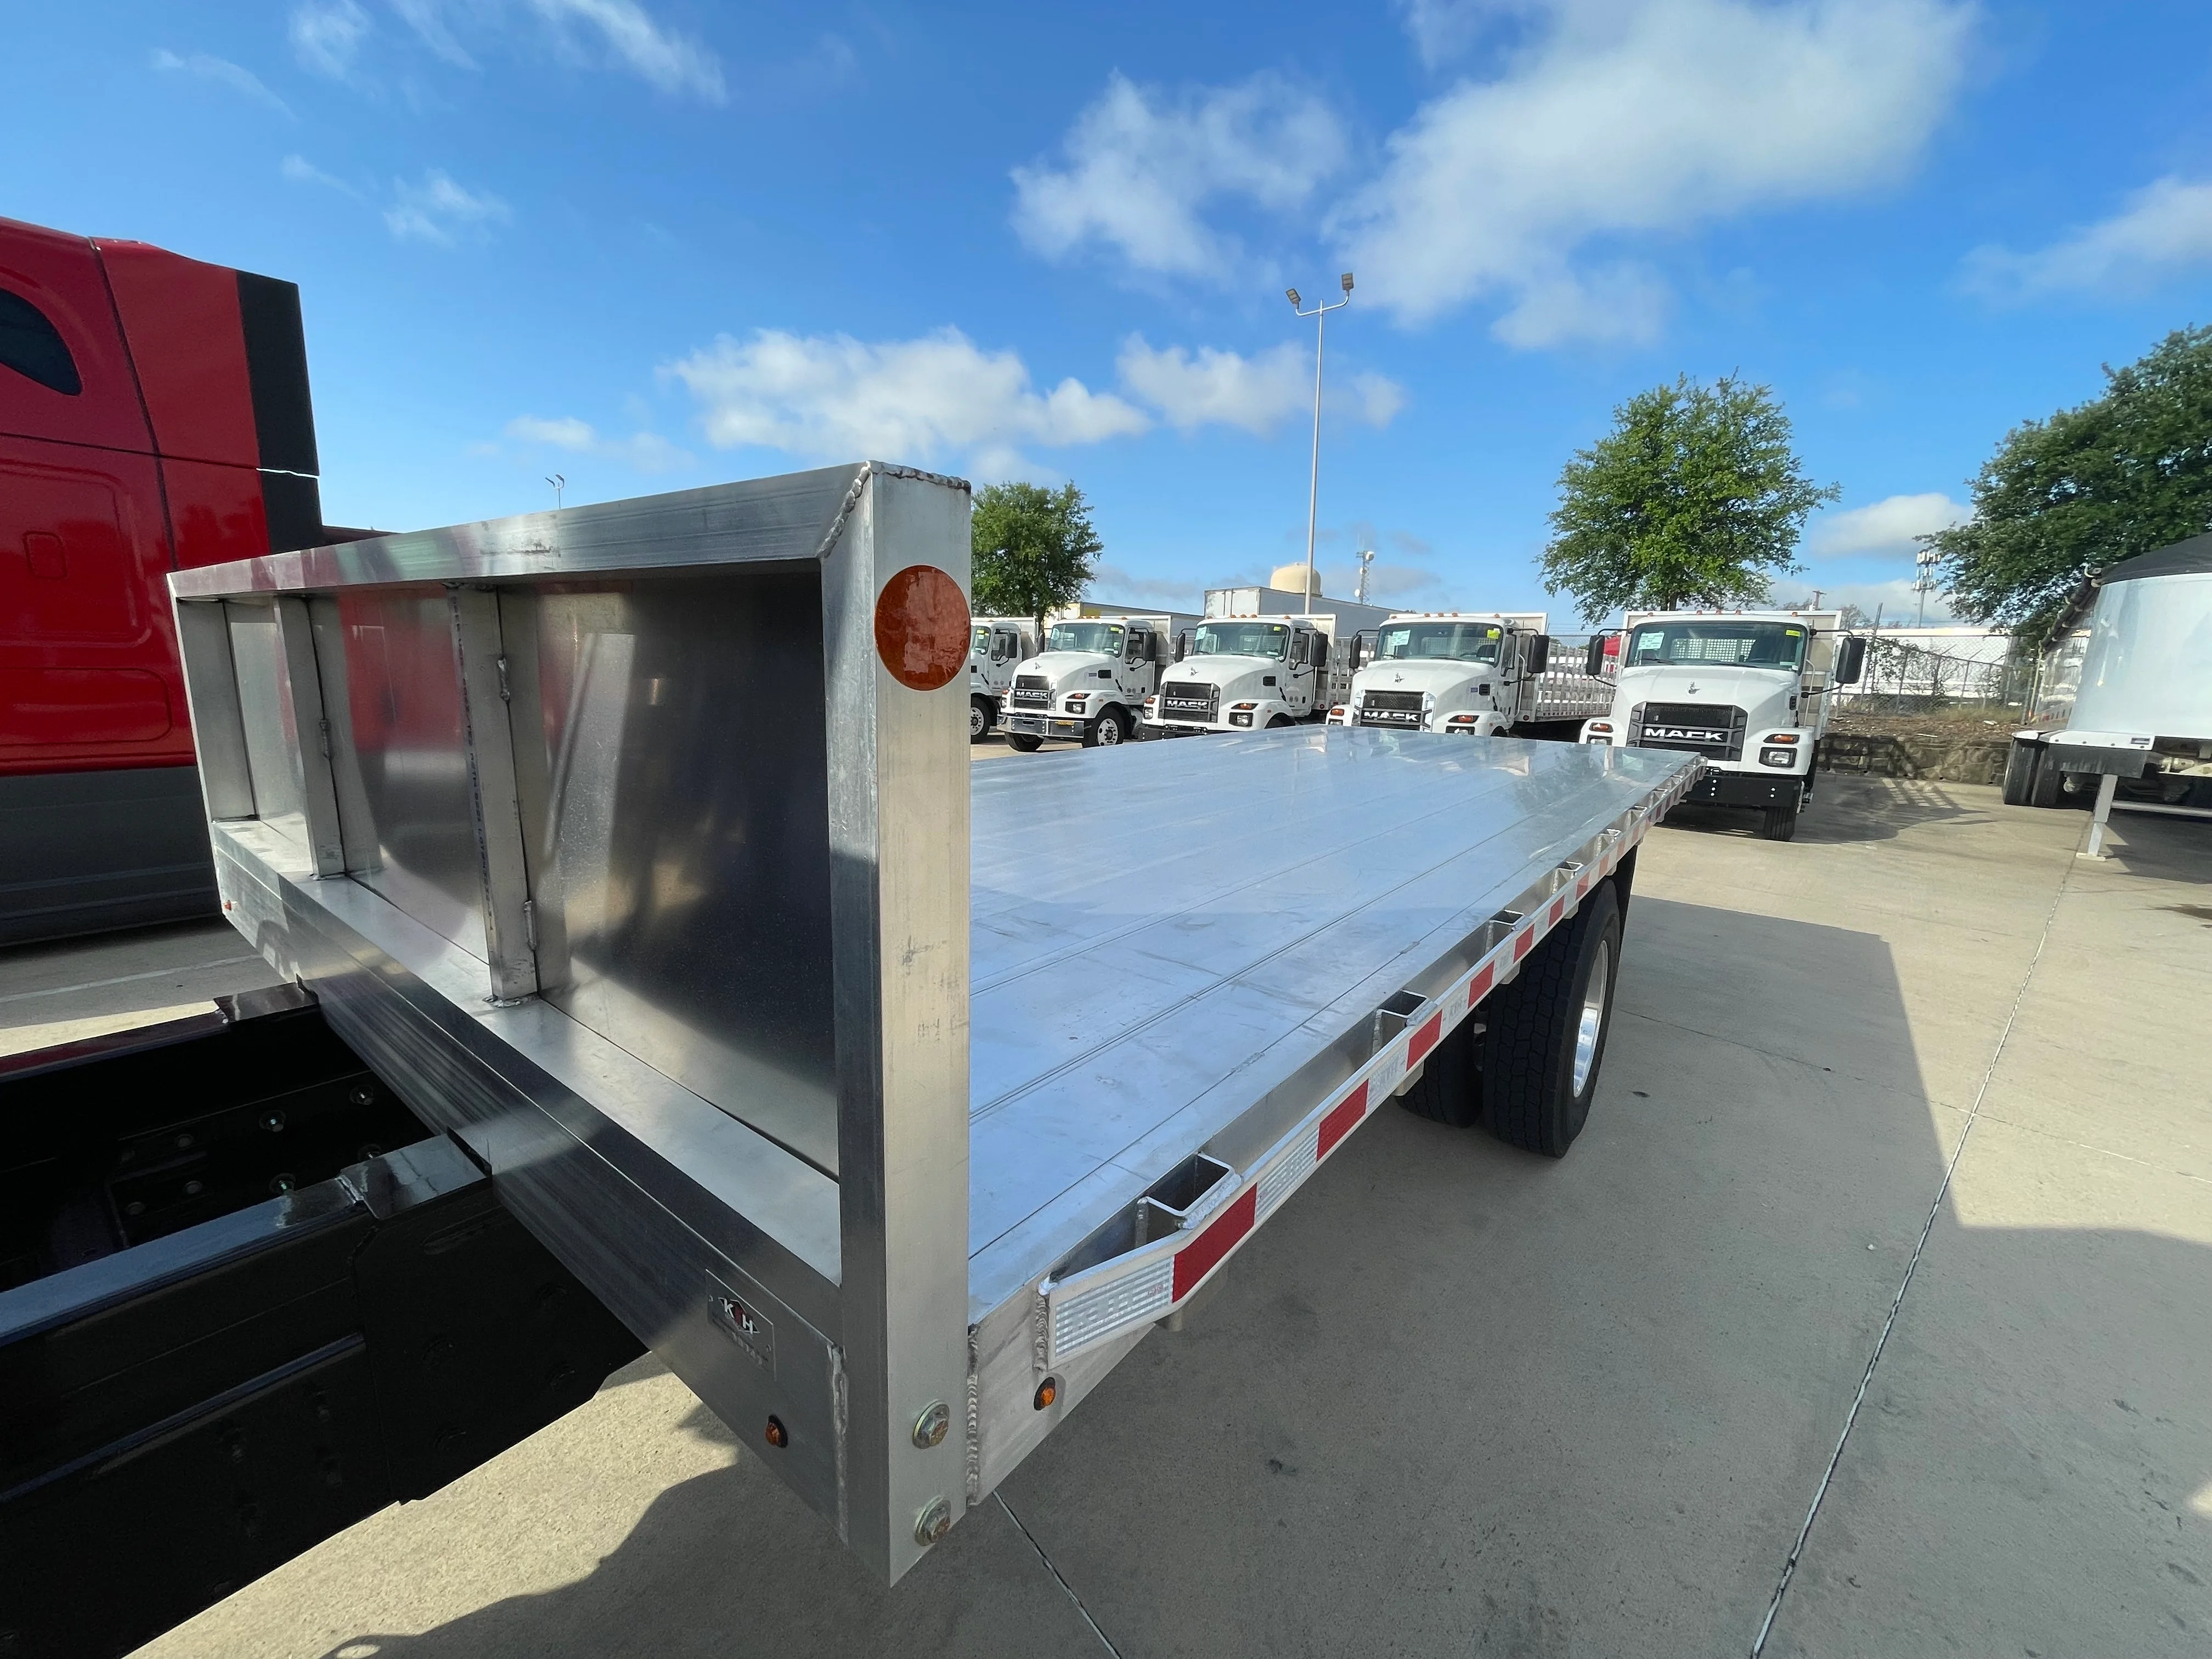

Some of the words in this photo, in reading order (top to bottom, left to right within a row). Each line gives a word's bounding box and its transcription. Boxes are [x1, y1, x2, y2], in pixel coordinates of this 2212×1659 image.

[1016, 691, 1047, 699] MACK
[1167, 700, 1207, 709] MACK
[1364, 711, 1418, 721] MACK
[1645, 728, 1724, 741] MACK
